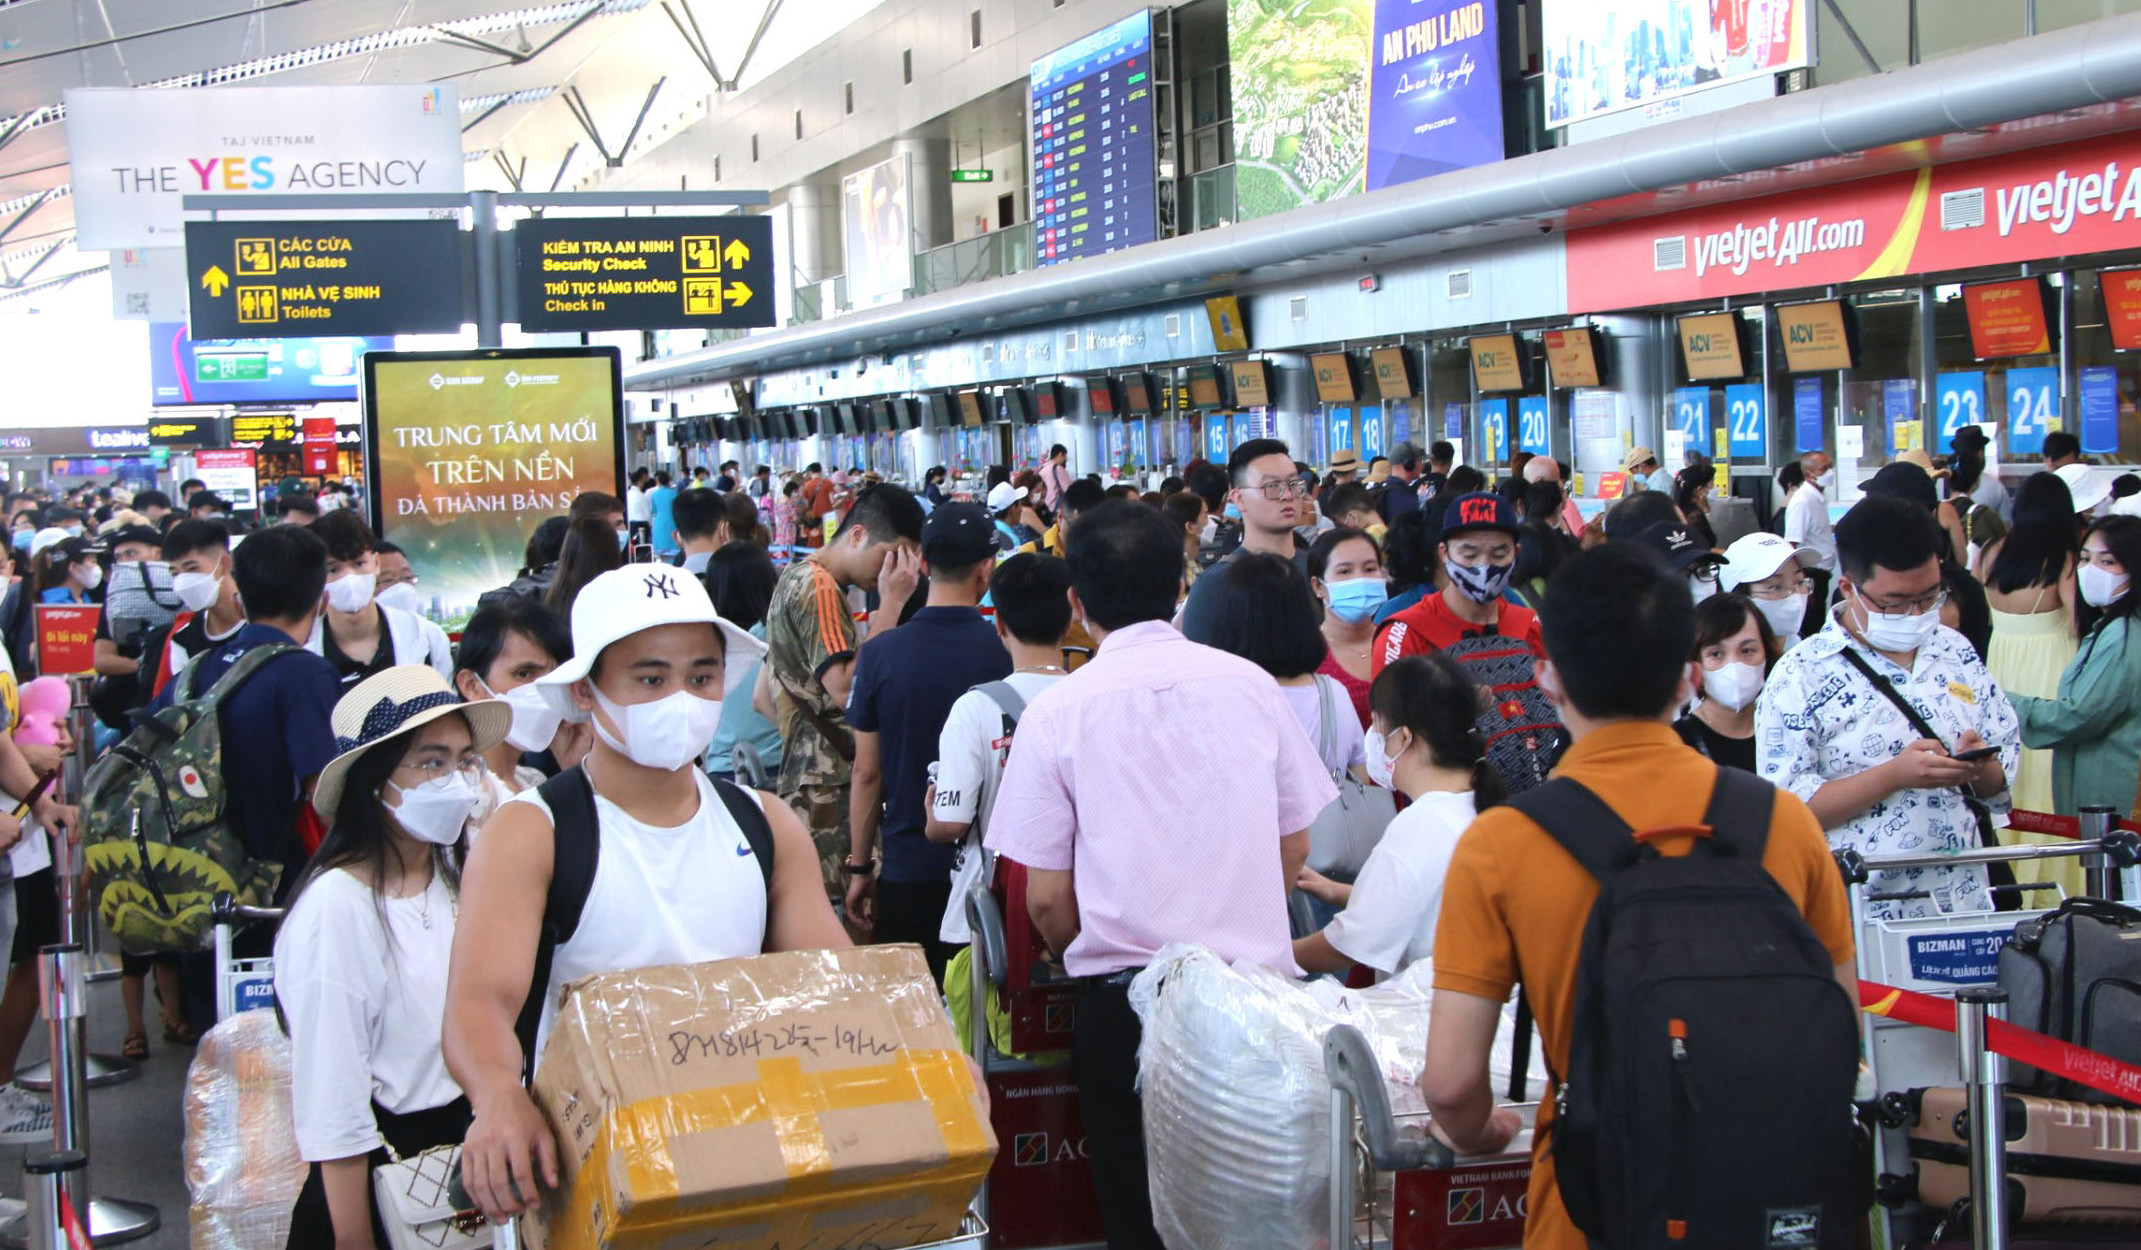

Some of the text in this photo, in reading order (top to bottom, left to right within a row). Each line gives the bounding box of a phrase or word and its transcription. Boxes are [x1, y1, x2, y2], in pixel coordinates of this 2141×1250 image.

[1383, 2, 1484, 66] AN PHU LAND
[222, 135, 315, 147] TAJ VIETNAM
[112, 155, 426, 193] THE YES AGENCY
[279, 237, 311, 252] CÁC
[583, 241, 611, 254] TRA
[613, 241, 636, 253] AN
[640, 240, 674, 253] NINH
[280, 255, 347, 269] All Gates
[543, 257, 647, 272] Security Check
[282, 285, 380, 303] NHÀ VỆ SINH
[544, 277, 677, 298] THỦ TỤC HÀNG KHÔNG
[282, 305, 331, 319] Toilets
[545, 299, 605, 313] Check in
[1790, 323, 1813, 344] ACV
[1732, 399, 1759, 441] 22
[2012, 385, 2051, 435] 24
[394, 414, 598, 448] TRUNG TÂM MỚI
[1522, 410, 1545, 447] 20
[1680, 402, 1704, 442] 21
[1210, 425, 1224, 453] 15
[1333, 420, 1348, 450] 17
[1363, 418, 1379, 456] 18
[426, 450, 575, 485] TRÊN NỀN
[434, 493, 506, 515] THÀNH
[512, 490, 554, 512] BẢN
[643, 574, 681, 599] NY
[1917, 938, 1966, 953] BIZMAN
[1006, 1085, 1029, 1099] NGÂN
[1031, 1084, 1054, 1098] HÀNG
[1451, 1173, 1489, 1185] VIETNAM
[1491, 1171, 1514, 1182] BANK
